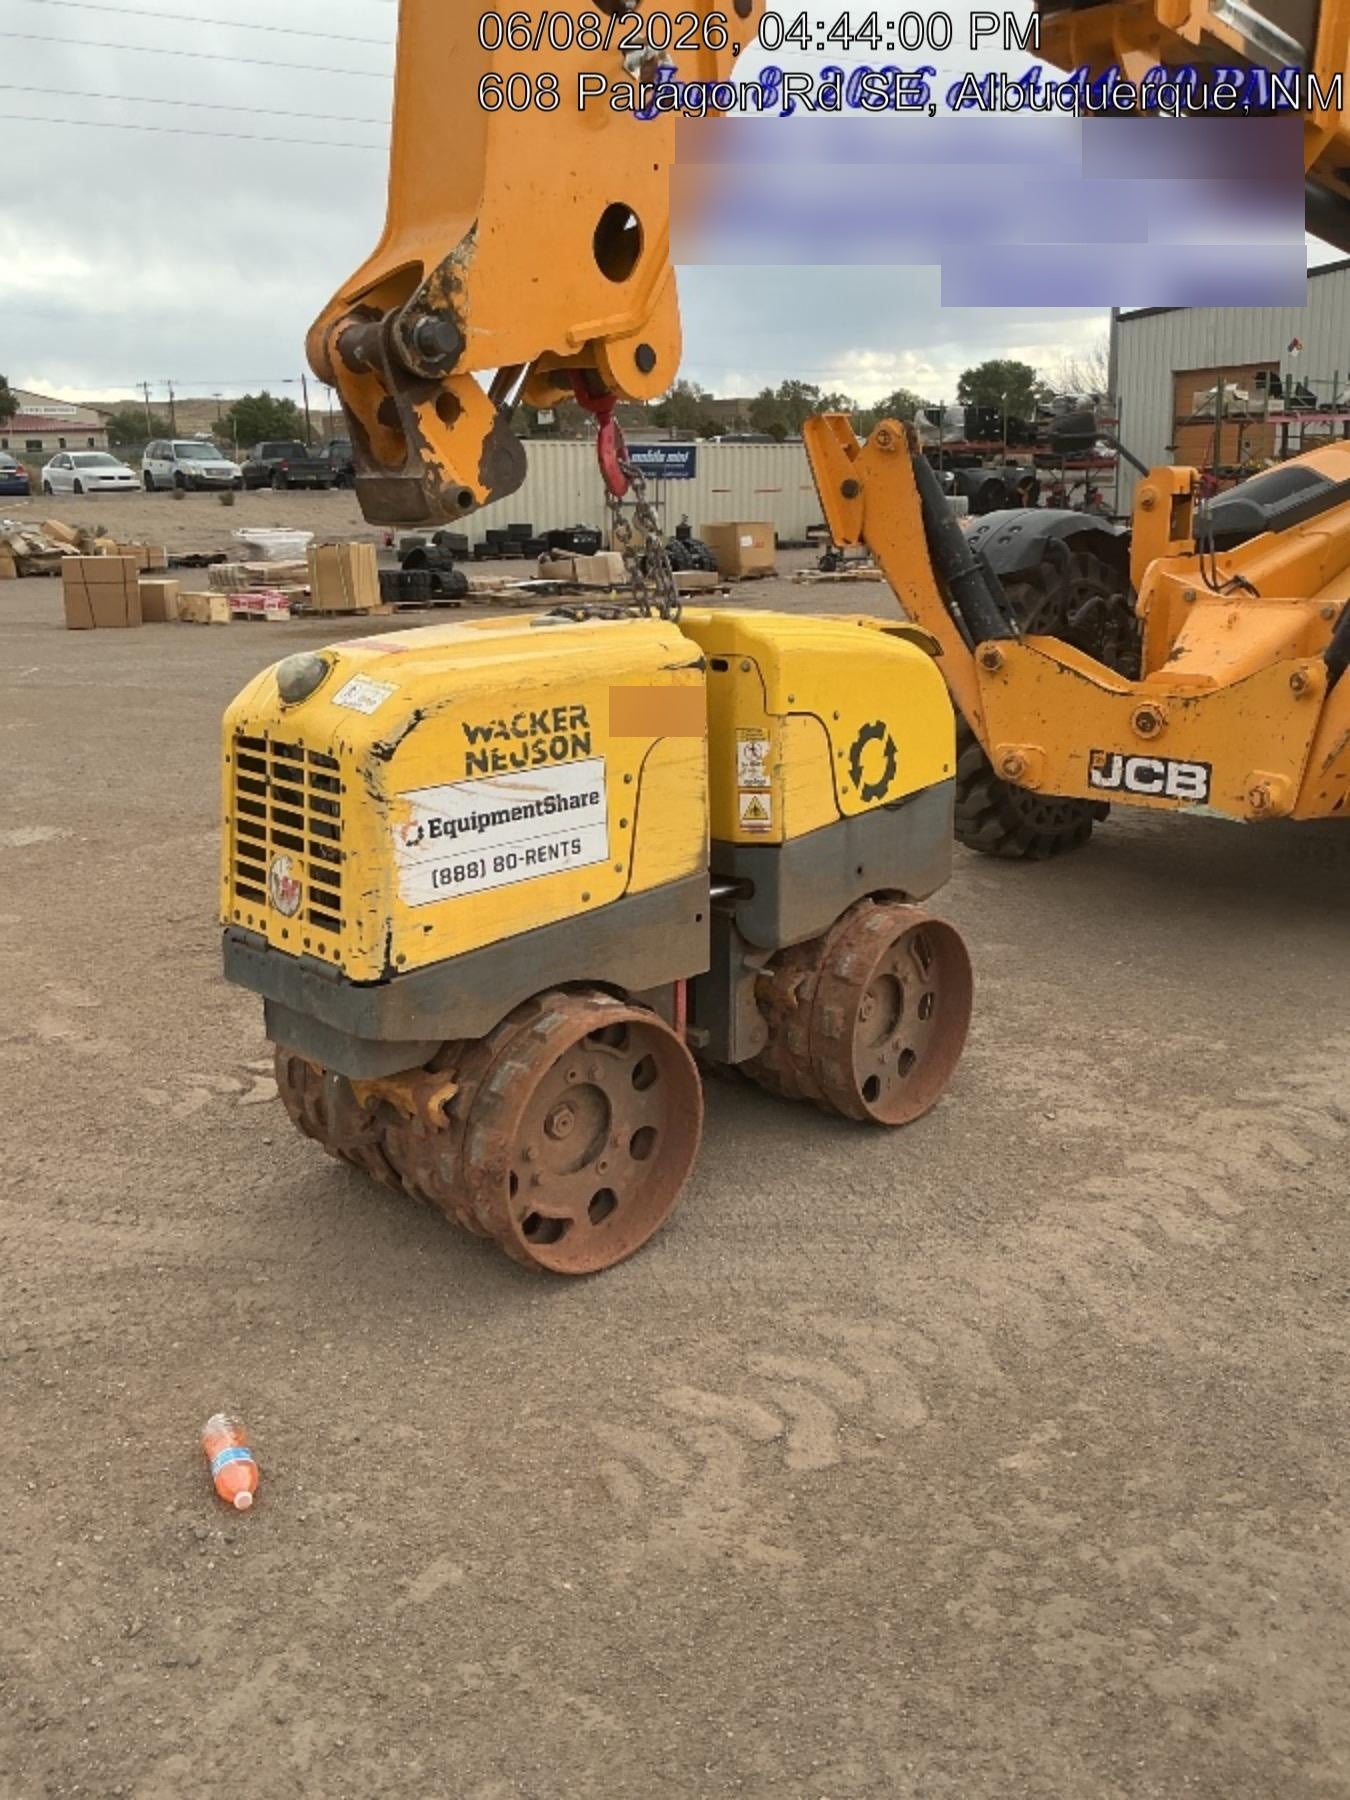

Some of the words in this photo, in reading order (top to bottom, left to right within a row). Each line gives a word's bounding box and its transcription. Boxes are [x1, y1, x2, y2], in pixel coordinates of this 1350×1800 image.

[462, 704, 590, 745] WACKER
[465, 731, 591, 776] NEUSON
[1091, 755, 1207, 799] JCB
[428, 791, 600, 839] EquipmentShare
[431, 859, 485, 888] (888)
[493, 839, 581, 874] 80-RENTS
